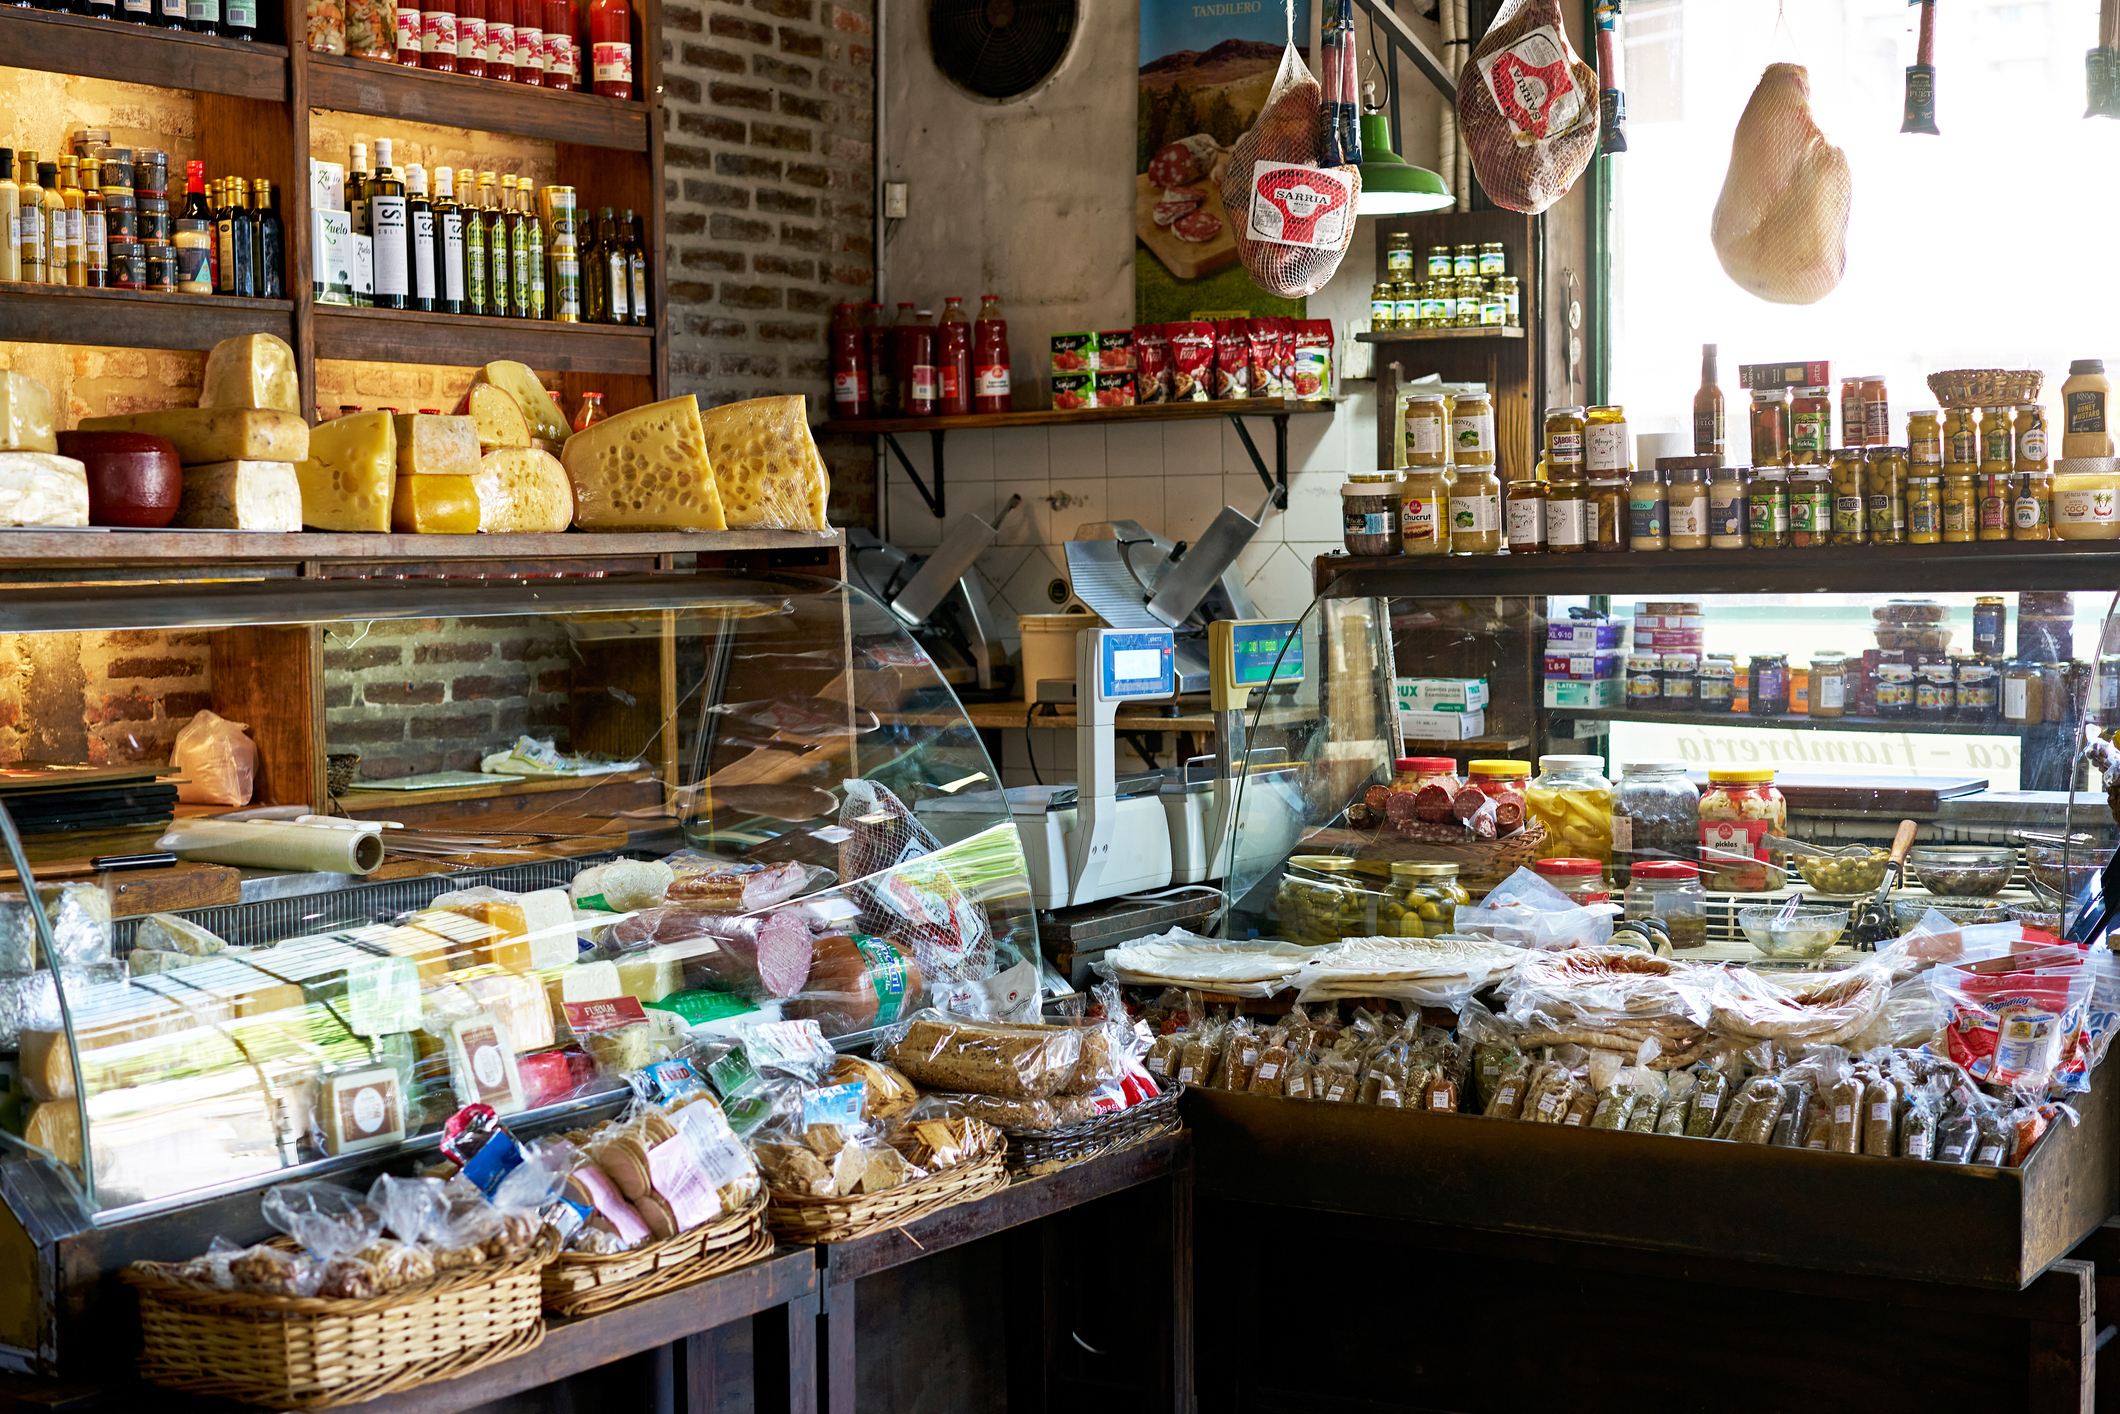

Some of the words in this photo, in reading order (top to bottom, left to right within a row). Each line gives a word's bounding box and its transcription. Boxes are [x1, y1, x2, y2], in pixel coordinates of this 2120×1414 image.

[1192, 1, 1262, 18] TANDILERO
[1513, 67, 1542, 121] SARRIA
[1276, 190, 1328, 205] SARRIA
[324, 217, 348, 244] Zuelo
[2076, 403, 2096, 414] HONEY
[2073, 409, 2101, 421] MUSTARD
[1553, 435, 1580, 446] SABORES
[2028, 446, 2042, 454] IPA
[1403, 513, 1431, 521] Chucrut
[2018, 512, 2031, 520] IPA
[1548, 631, 1557, 639] XL
[1554, 662, 1566, 670] 8-9
[1467, 685, 1480, 694] TRUX
[1715, 840, 1738, 849] pickles
[1984, 996, 2032, 1012] Rapiditas
